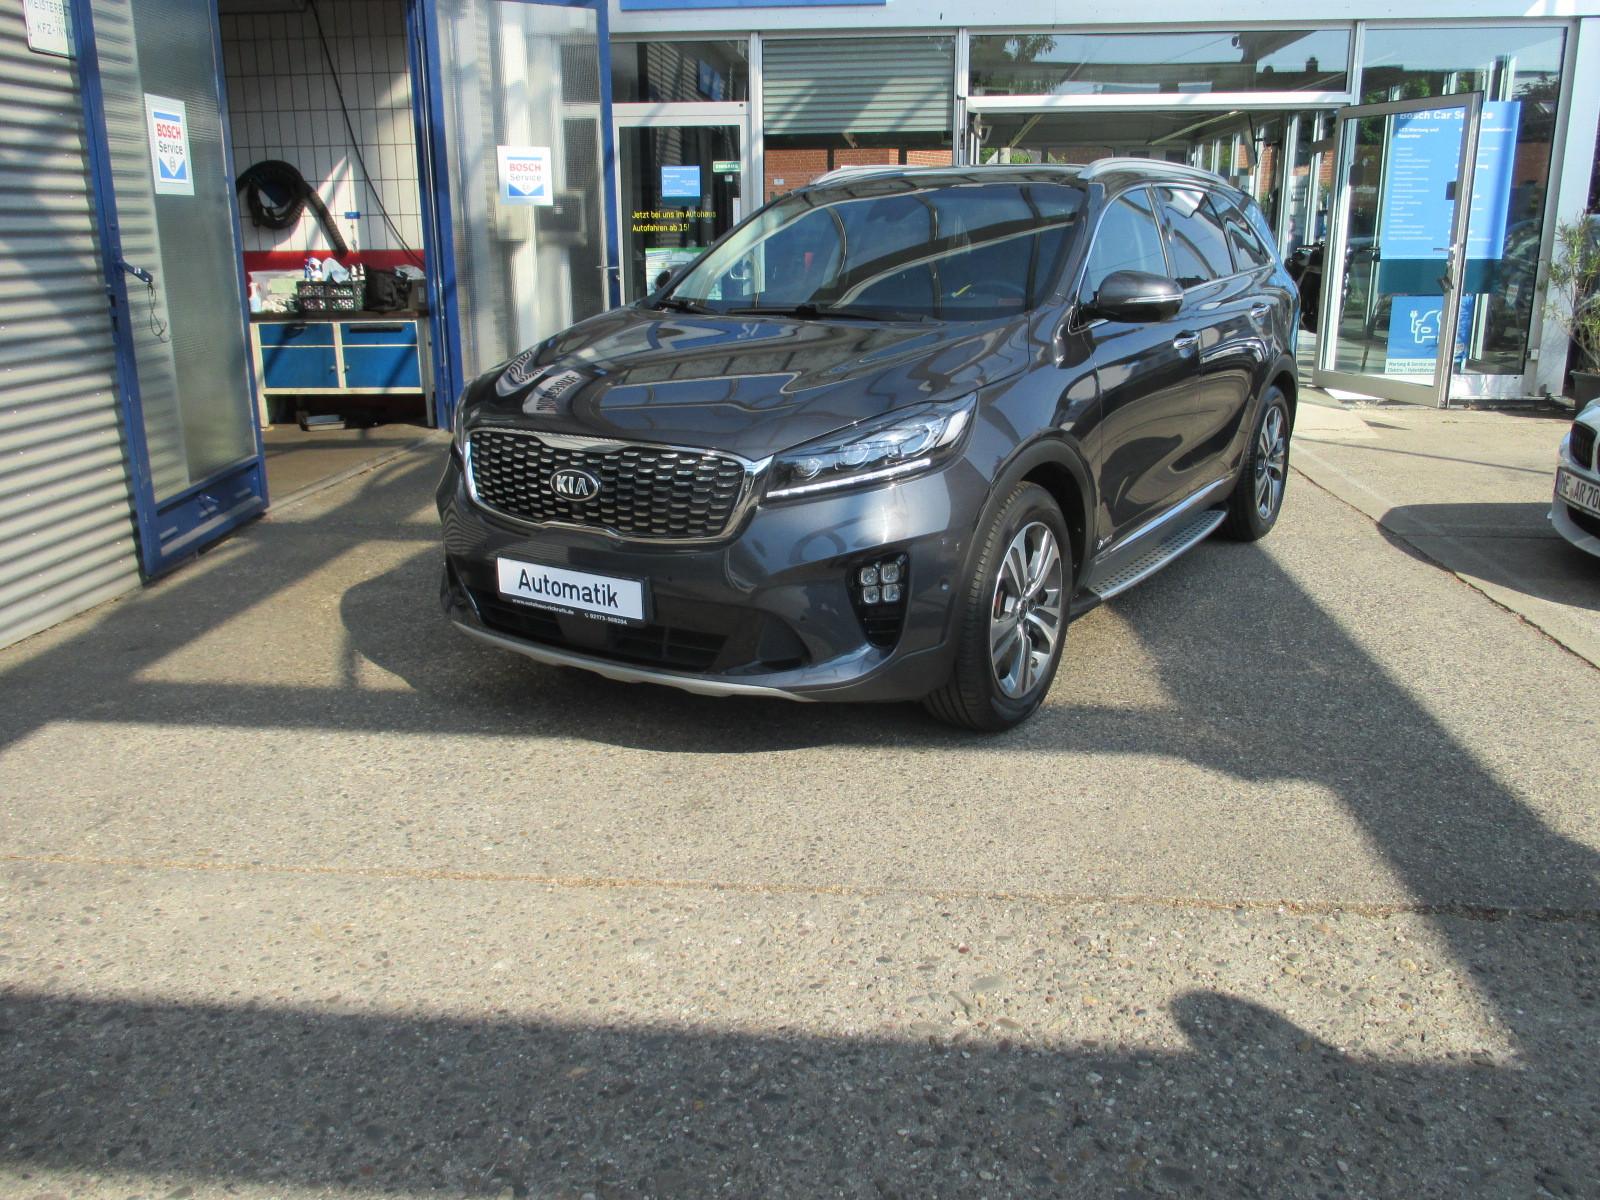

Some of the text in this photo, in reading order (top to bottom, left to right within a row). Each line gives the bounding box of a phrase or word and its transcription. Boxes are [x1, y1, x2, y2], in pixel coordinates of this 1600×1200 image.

[1433, 111, 1451, 120] Car
[156, 123, 182, 140] BOSCH
[159, 141, 183, 155] Service
[509, 163, 541, 172] BOSCH
[632, 211, 649, 219] Jetzt
[686, 210, 716, 218] Autohaus
[632, 224, 668, 232] Autofahren
[679, 224, 690, 232] 15!
[556, 474, 589, 496] KIA
[518, 568, 619, 609] Automatik
